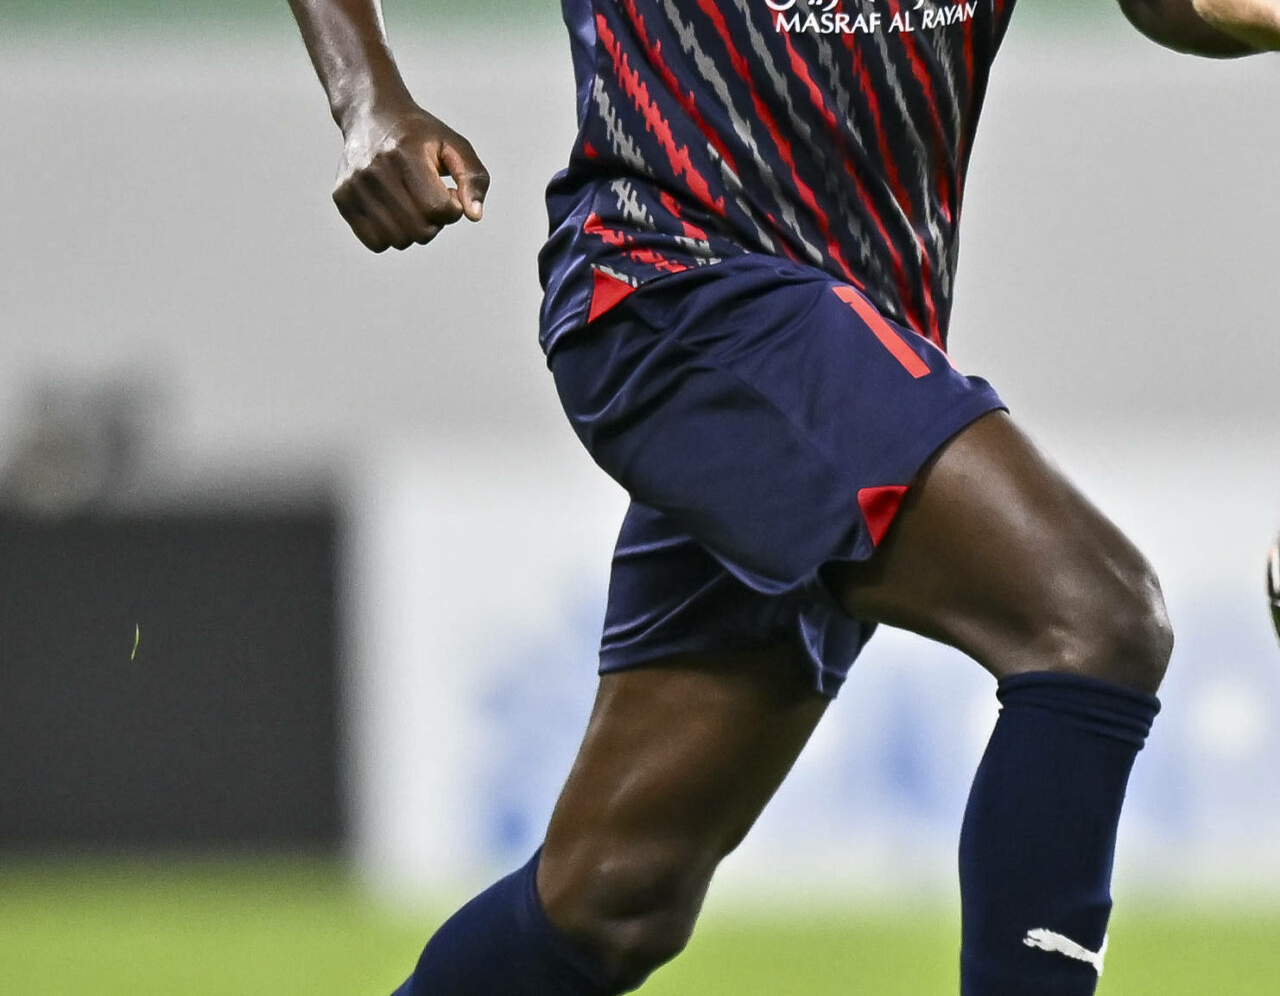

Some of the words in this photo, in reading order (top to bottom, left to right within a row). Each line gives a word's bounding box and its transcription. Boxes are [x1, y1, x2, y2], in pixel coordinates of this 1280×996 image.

[775, 12, 882, 34] MASRAF
[888, 9, 915, 33] AL
[921, 0, 978, 30] RAYAN
